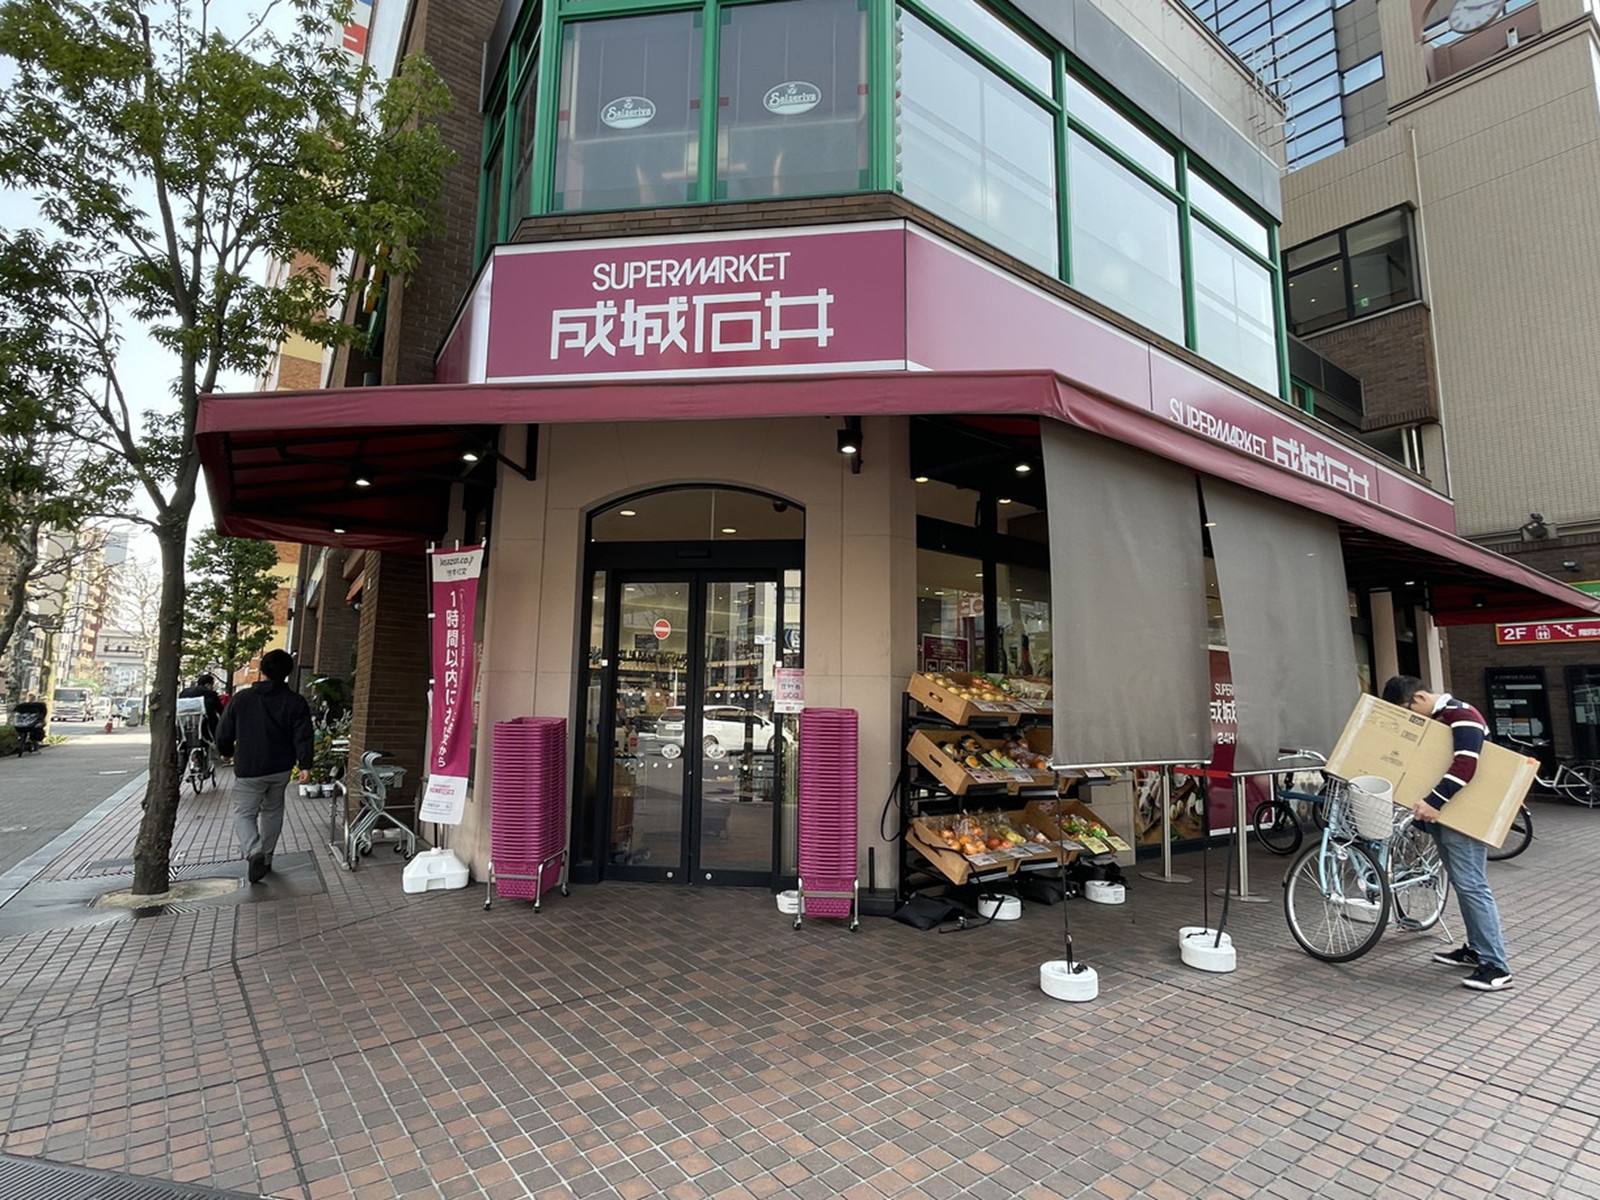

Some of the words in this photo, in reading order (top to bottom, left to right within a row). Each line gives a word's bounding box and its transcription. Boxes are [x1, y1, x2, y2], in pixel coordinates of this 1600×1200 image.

[592, 252, 791, 292] SUPERMARKET
[550, 288, 834, 360] 成城石井
[1169, 397, 1267, 459] SUPERMARKET
[1503, 627, 1527, 640] 2F
